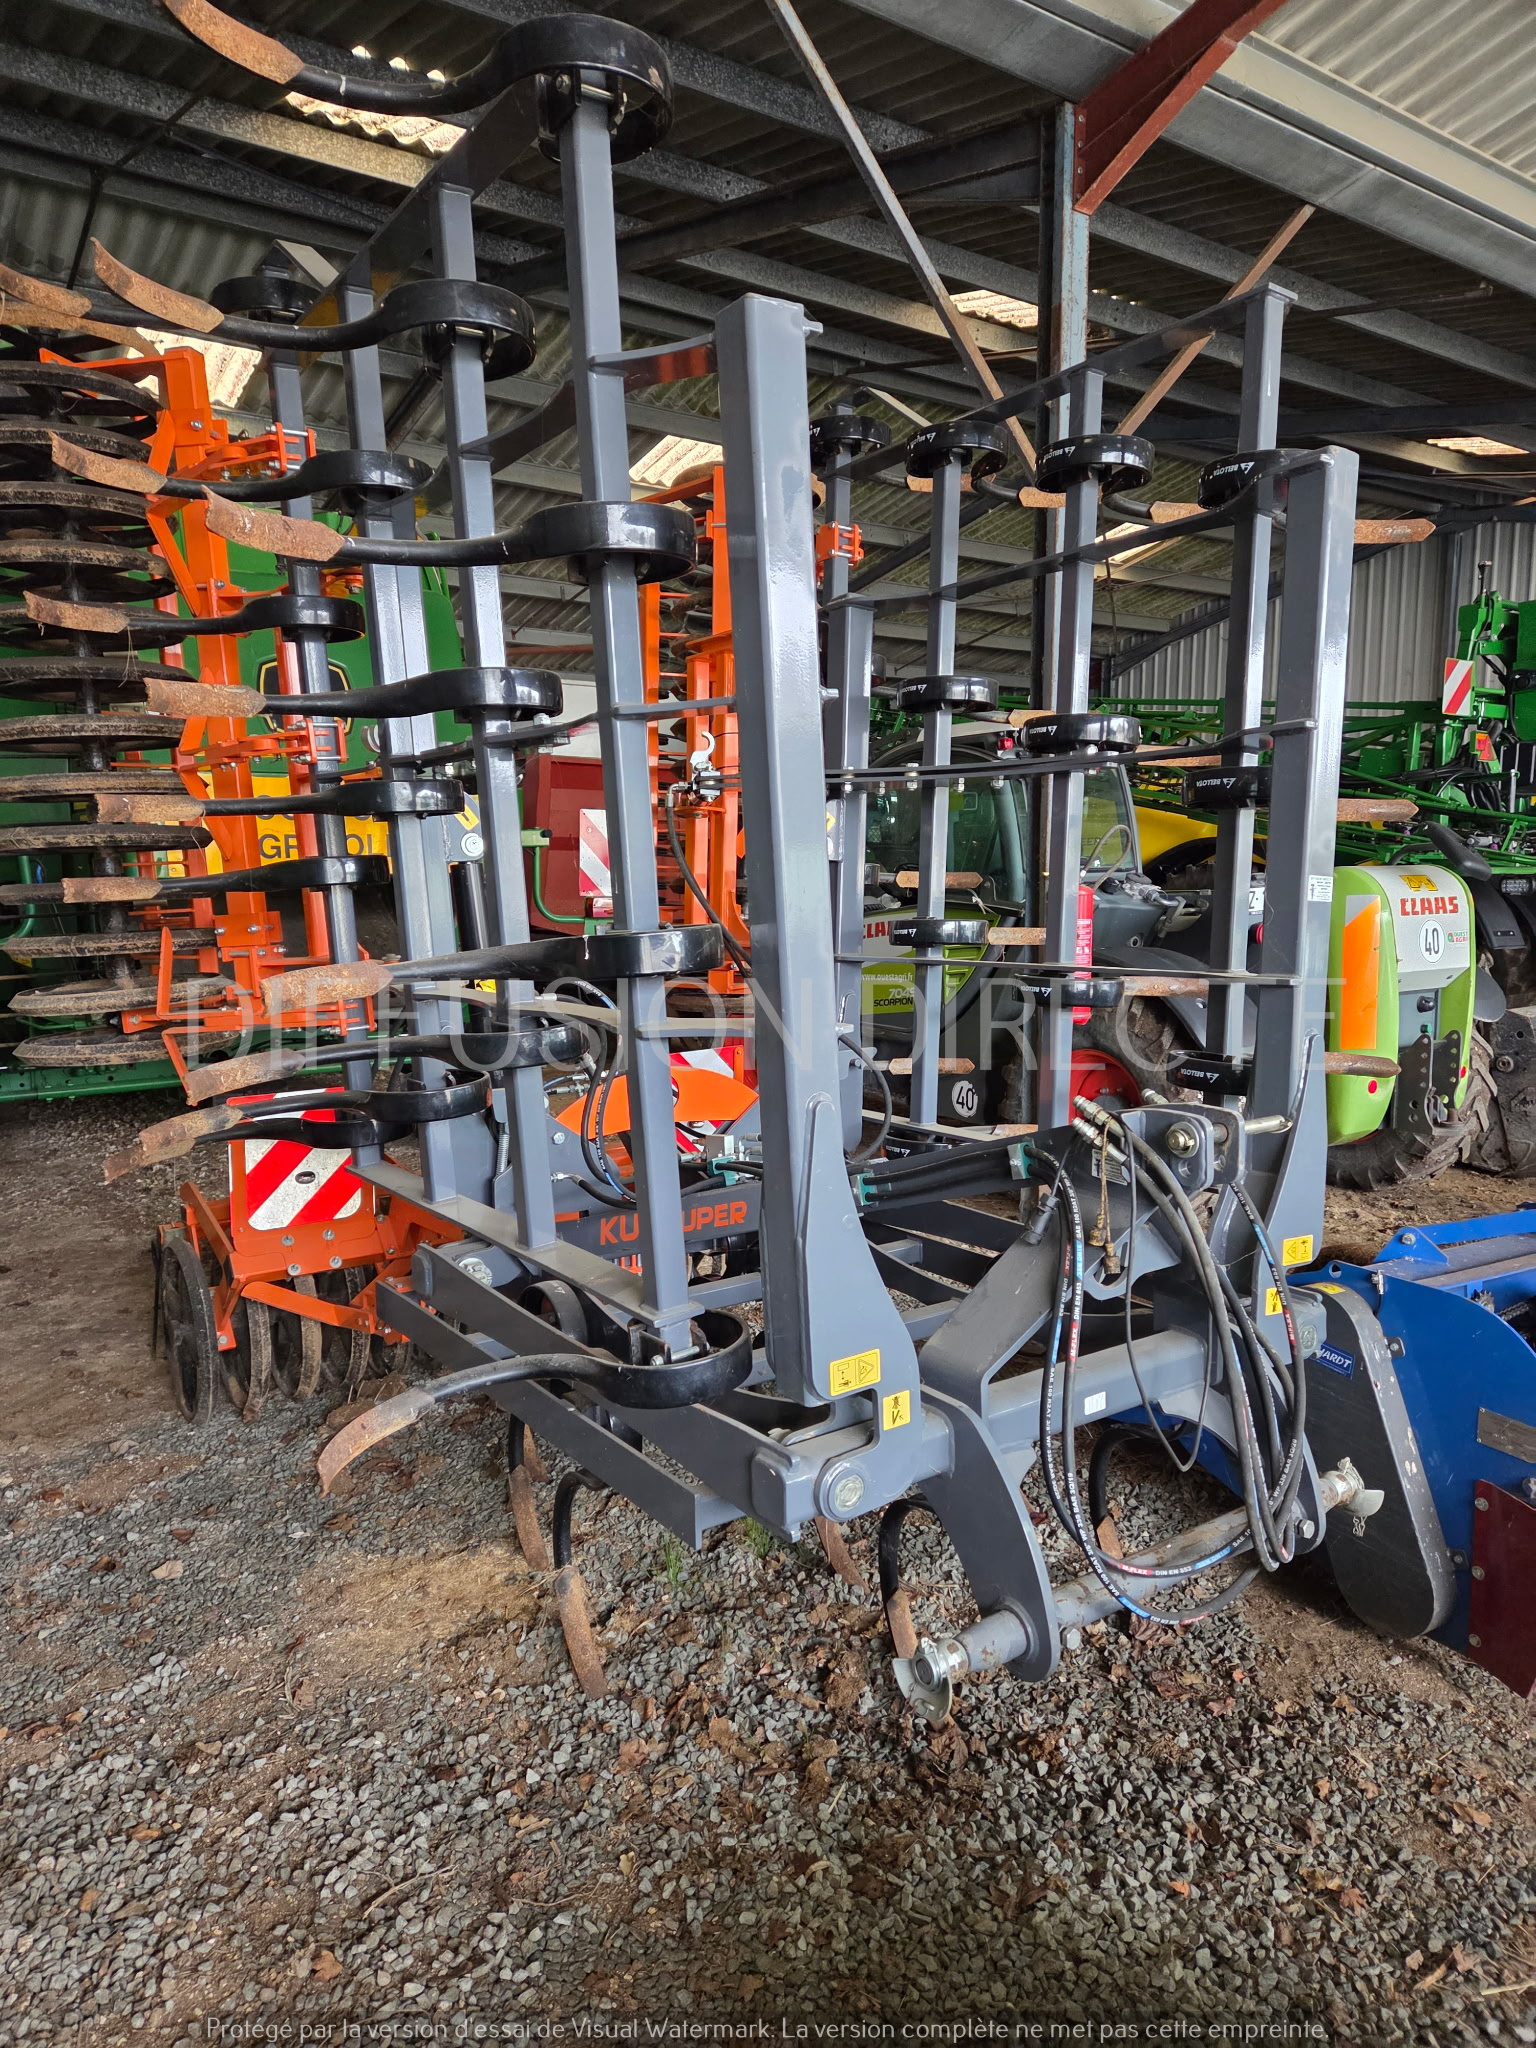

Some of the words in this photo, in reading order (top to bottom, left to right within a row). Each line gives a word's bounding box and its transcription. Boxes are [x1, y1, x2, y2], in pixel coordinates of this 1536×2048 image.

[1212, 464, 1239, 477] BELLOTA
[1196, 778, 1222, 787] BELLOTA
[1399, 896, 1459, 916] CLAAS
[1424, 927, 1441, 956] 40
[873, 997, 915, 1007] SCORPION
[1180, 1068, 1205, 1078] BELLOTA
[956, 1086, 975, 1111] 40
[1245, 1205, 1255, 1220] SAE
[600, 1213, 640, 1246] KU
[682, 1200, 748, 1232] UPER
[1075, 1282, 1083, 1295] 853
[1074, 1295, 1082, 1306] EN
[1073, 1307, 1081, 1320] DIN
[1048, 1463, 1056, 1480] BAR
[1283, 1458, 1293, 1474] BAR
[1071, 1496, 1080, 1514] BAR
[1075, 1514, 1084, 1528] 330
[1079, 1529, 1088, 1542] WP
[1232, 1537, 1246, 1548] SAE
[1090, 1556, 1102, 1574] R2AT
[1121, 1563, 1148, 1576] M-FLEX
[1100, 1573, 1110, 1585] 100
[1108, 1584, 1120, 1597] SAE
